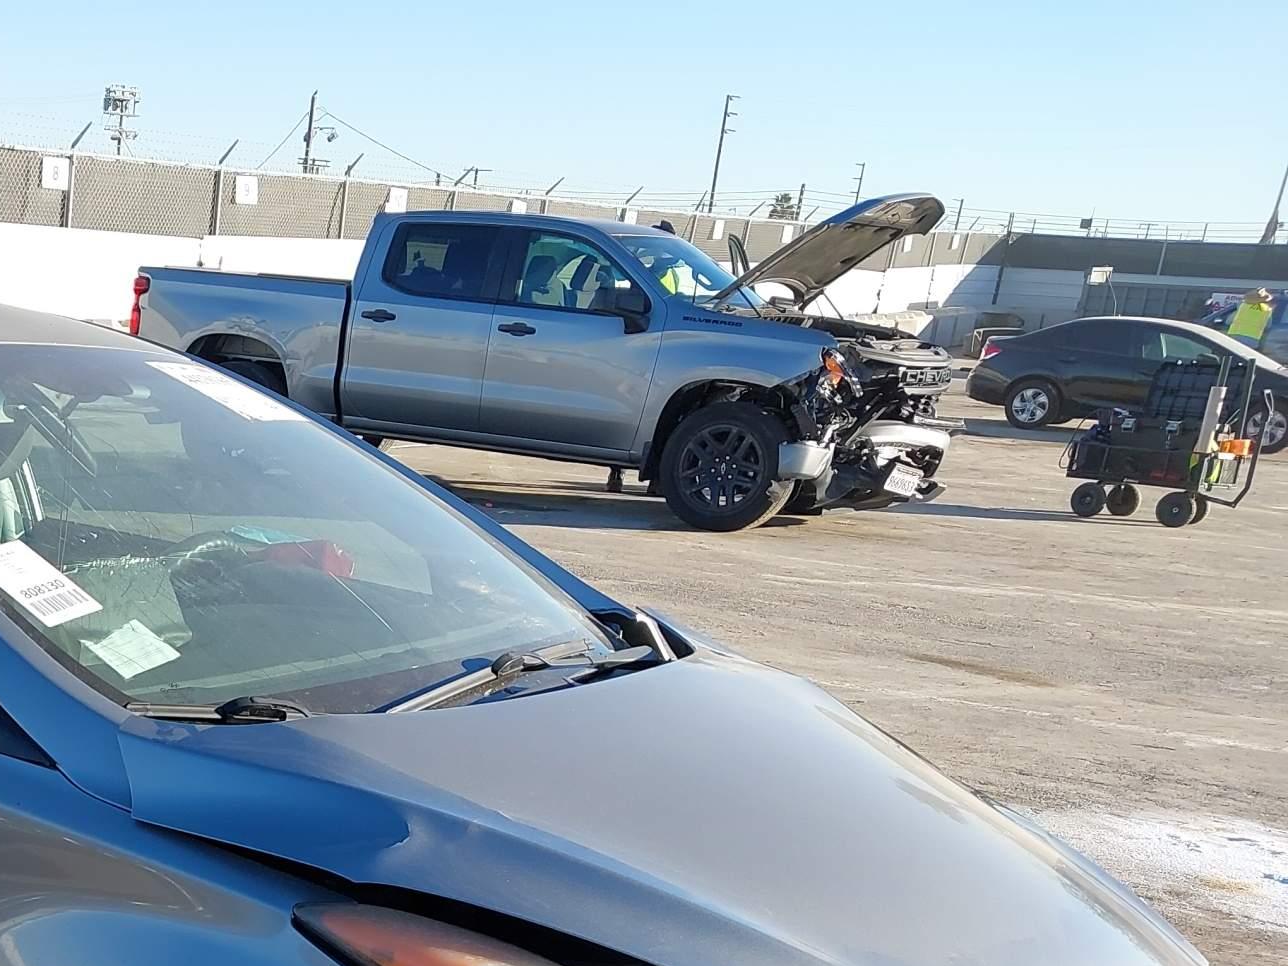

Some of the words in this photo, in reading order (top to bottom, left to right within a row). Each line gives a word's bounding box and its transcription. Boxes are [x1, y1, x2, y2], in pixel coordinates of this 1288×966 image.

[52, 165, 60, 181] 8
[682, 316, 744, 327] SILVERADO
[20, 579, 66, 599] 808130
